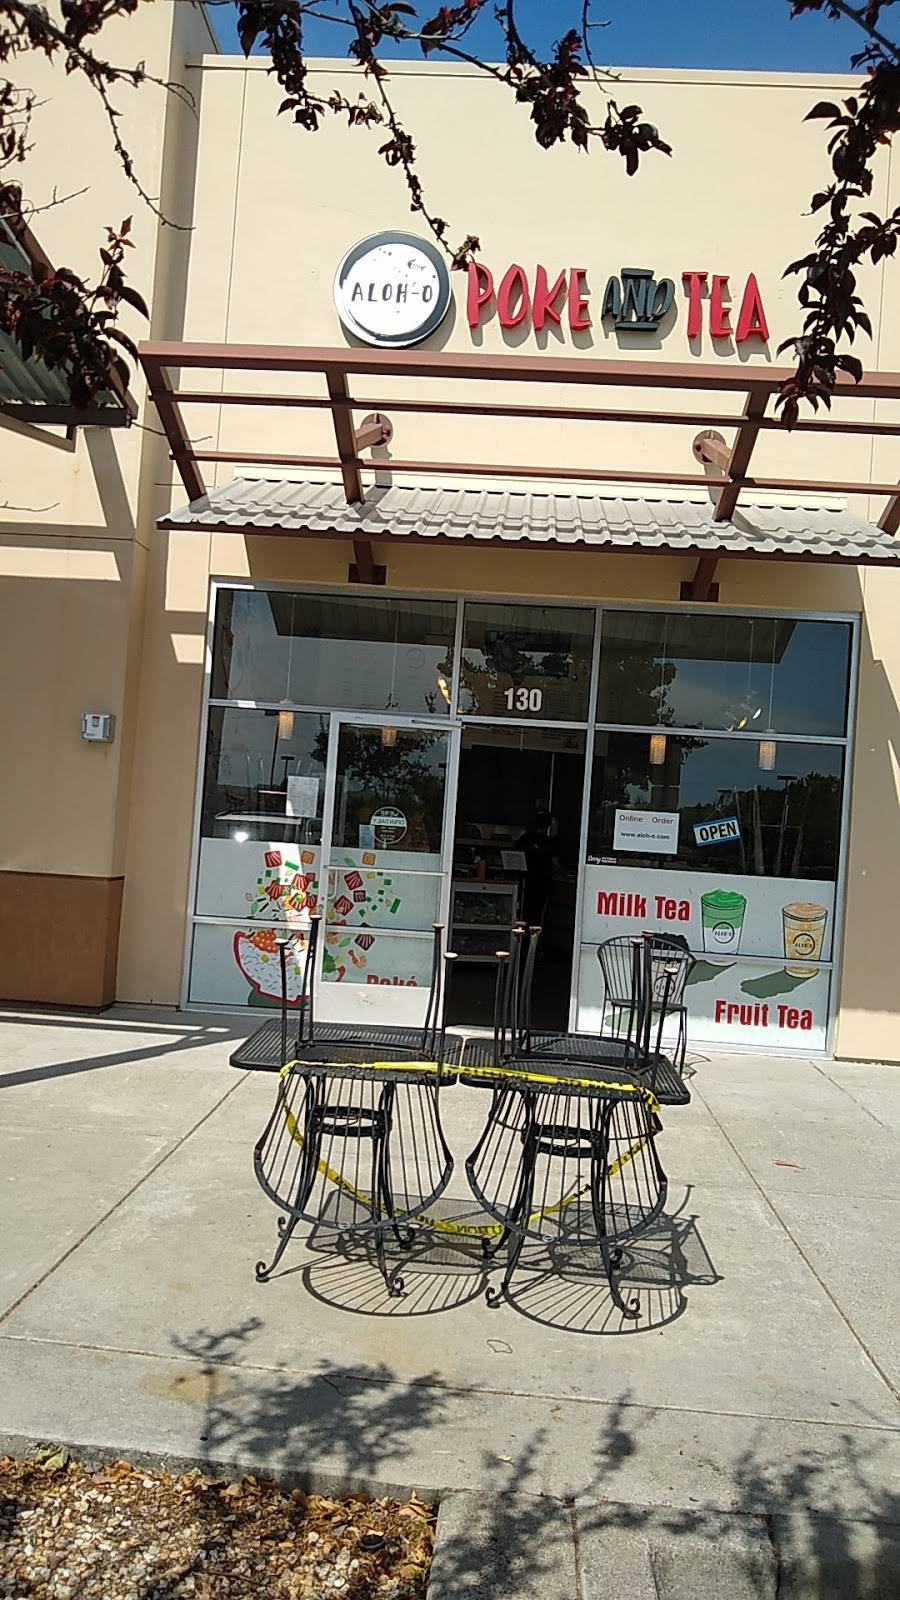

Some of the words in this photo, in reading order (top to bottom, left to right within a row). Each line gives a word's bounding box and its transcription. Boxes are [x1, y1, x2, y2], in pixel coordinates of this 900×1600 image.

[467, 262, 592, 329] POKE
[602, 268, 678, 331] AND
[681, 271, 769, 343] TEA
[503, 686, 543, 713] 130
[619, 813, 644, 824] Online
[651, 815, 674, 825] Order
[698, 821, 738, 842] OPEN
[597, 891, 646, 918] Milk
[654, 896, 690, 921] Tea
[715, 1000, 769, 1027] Fruit
[777, 1004, 812, 1030] Tea
